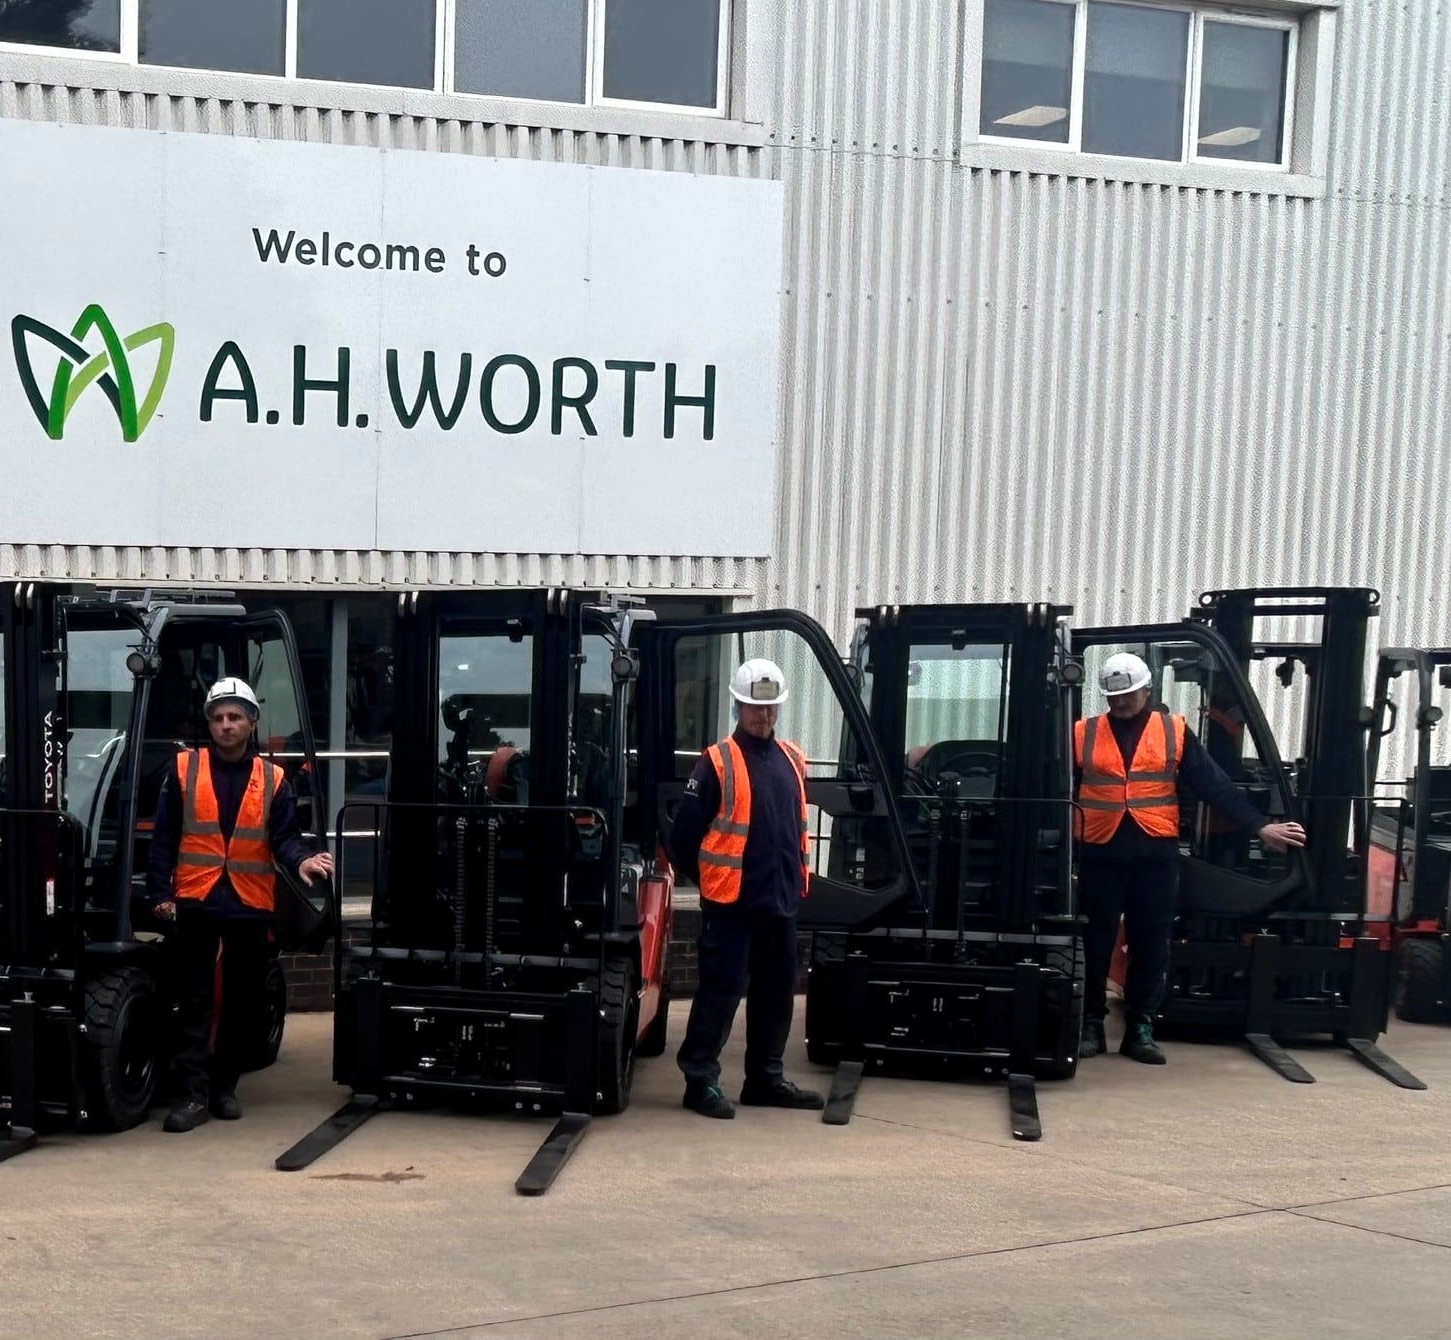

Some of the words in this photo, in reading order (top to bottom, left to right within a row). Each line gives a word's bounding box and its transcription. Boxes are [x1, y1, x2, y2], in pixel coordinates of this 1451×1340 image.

[251, 227, 446, 273] Welcome
[466, 244, 507, 278] to
[44, 710, 53, 804] TOYOTA
